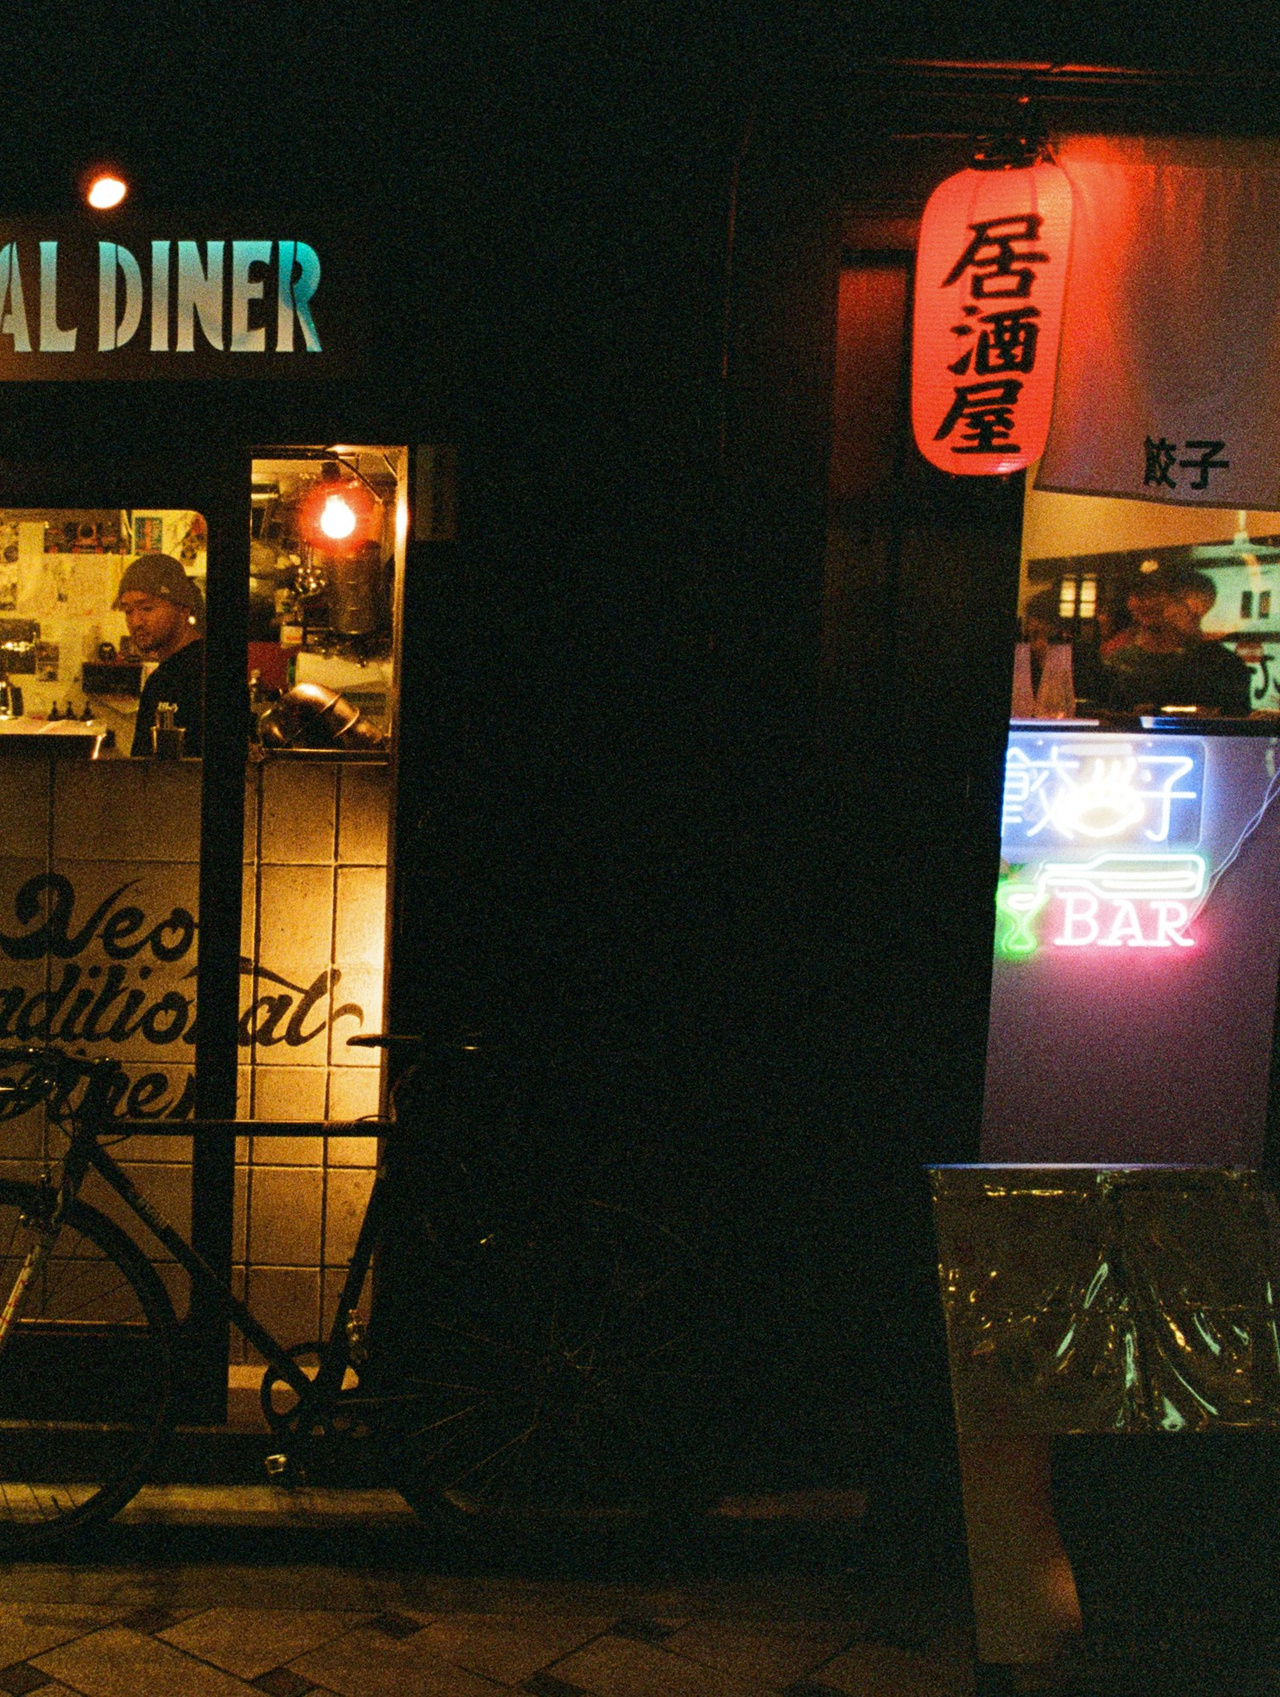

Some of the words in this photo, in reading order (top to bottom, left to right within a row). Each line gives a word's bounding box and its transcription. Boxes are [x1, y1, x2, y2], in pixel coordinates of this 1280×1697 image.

[97, 239, 322, 353] DINER
[932, 212, 1051, 455] 居酒屋
[1143, 435, 1230, 490] 餃子
[1053, 887, 1196, 947] BAR
